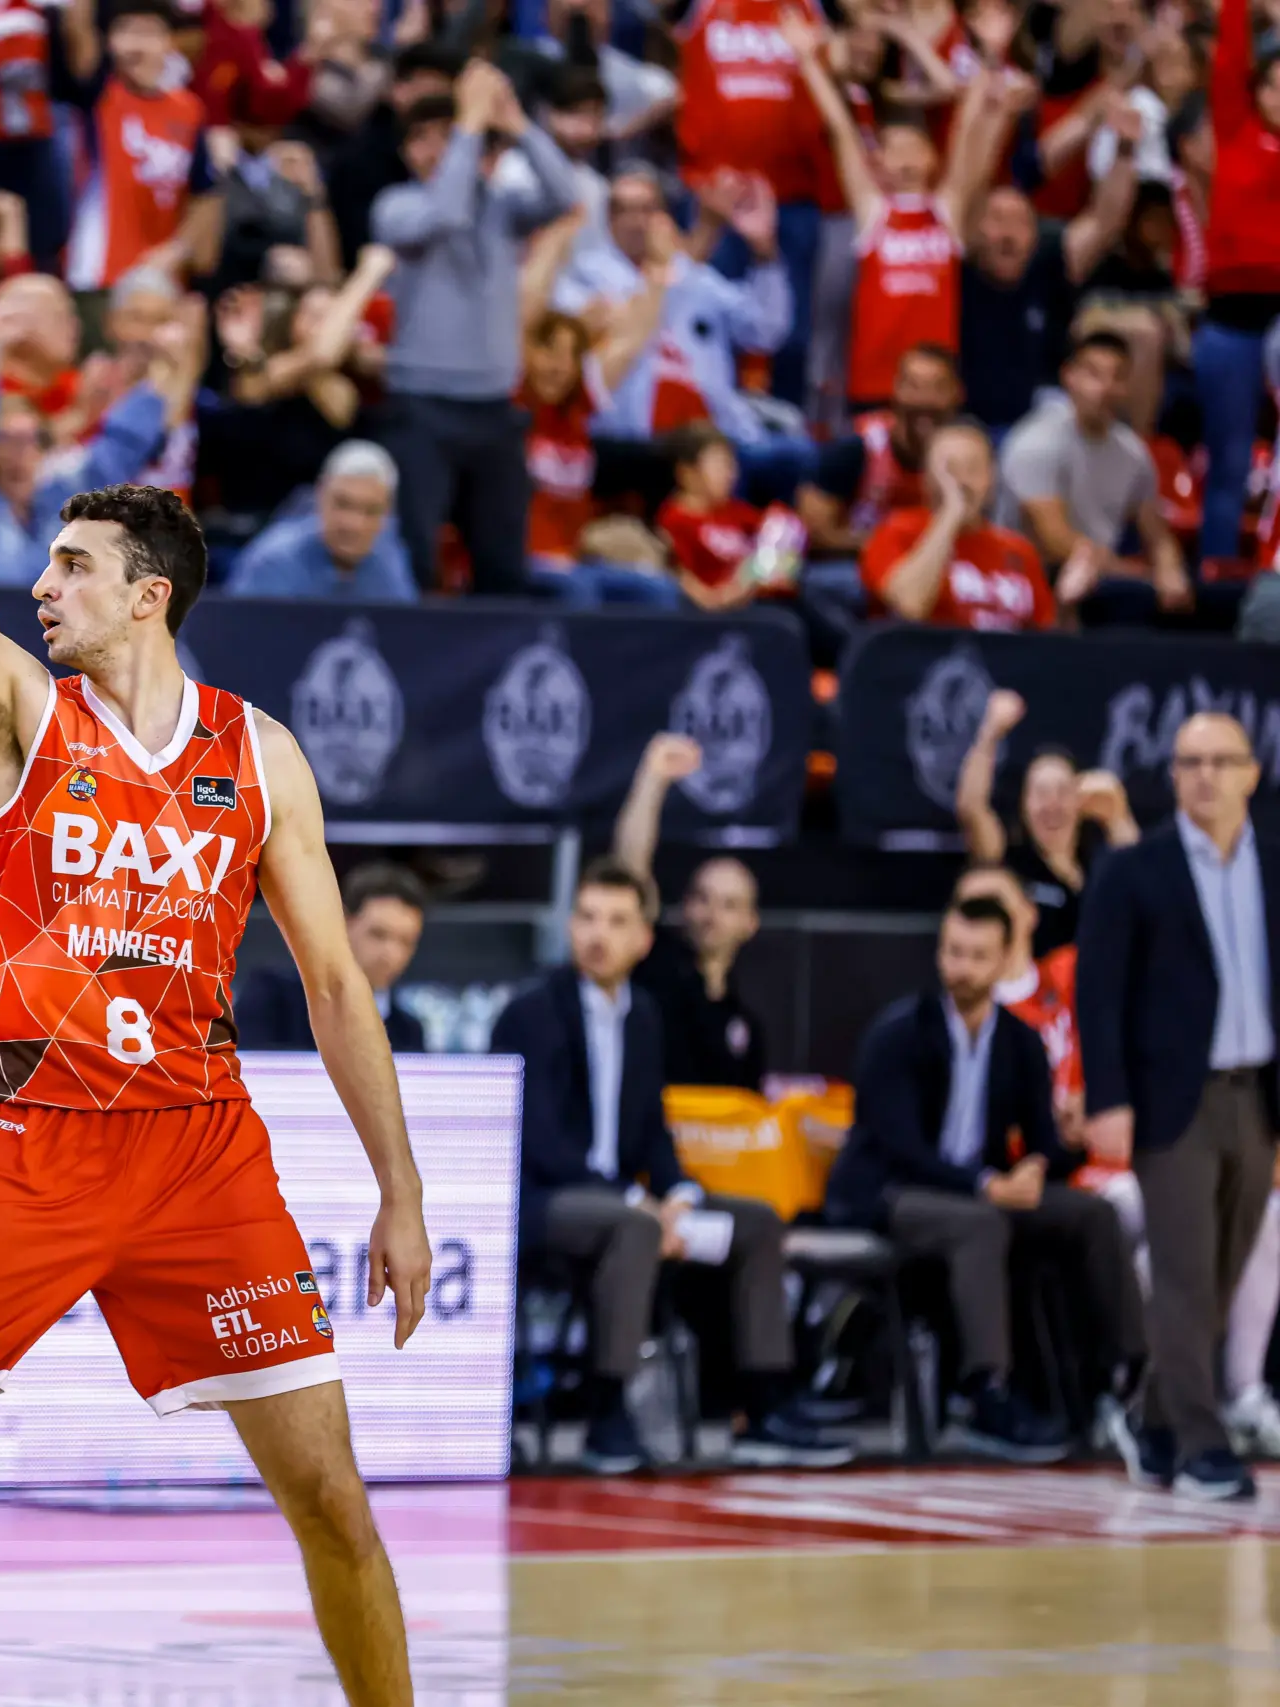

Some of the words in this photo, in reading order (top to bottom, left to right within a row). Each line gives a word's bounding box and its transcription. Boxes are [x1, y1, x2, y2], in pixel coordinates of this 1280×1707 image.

[197, 784, 216, 795] liga
[197, 793, 234, 806] endesa
[51, 811, 237, 895] BAXI
[52, 881, 216, 924] CLIMATIZACIÓN
[67, 924, 193, 974] MANRESA
[106, 996, 156, 1066] 8
[206, 1275, 291, 1313] Adbisio
[211, 1308, 262, 1339] ETL
[220, 1326, 309, 1359] GLOBAL
